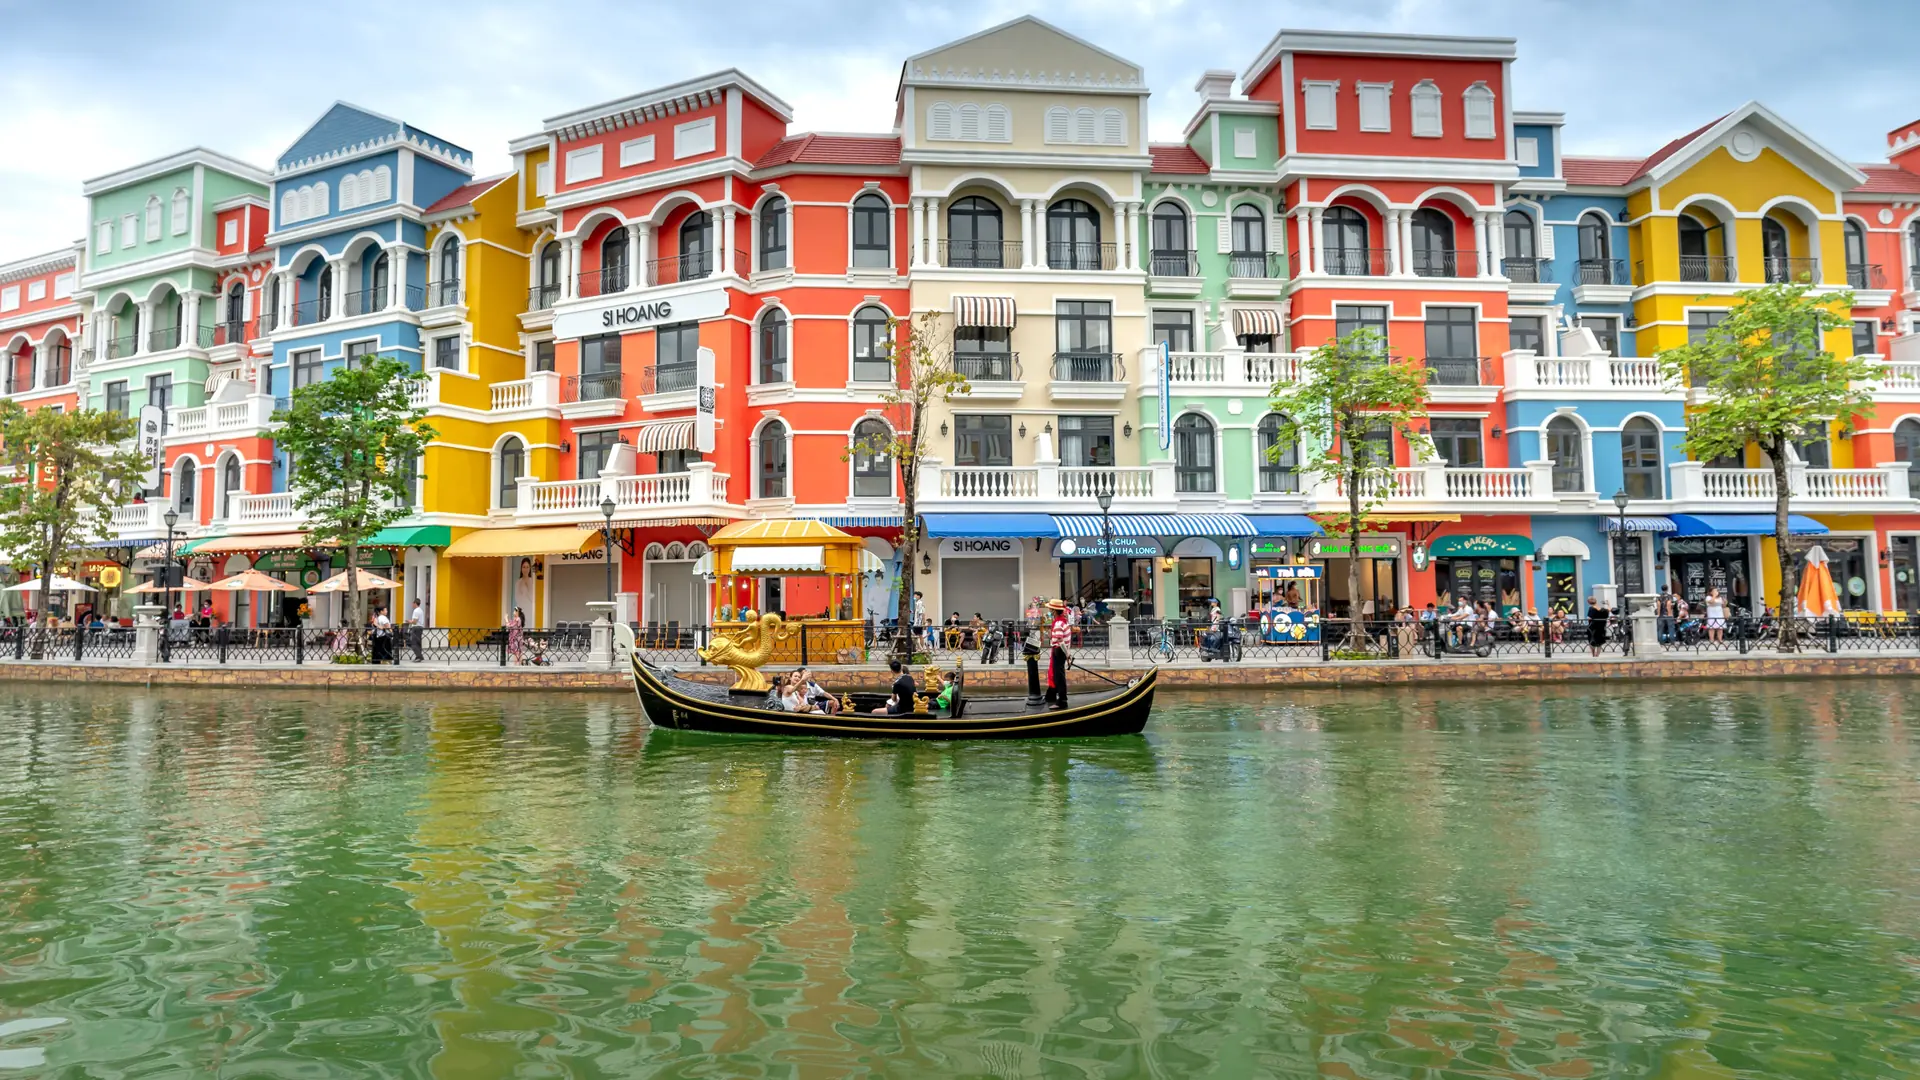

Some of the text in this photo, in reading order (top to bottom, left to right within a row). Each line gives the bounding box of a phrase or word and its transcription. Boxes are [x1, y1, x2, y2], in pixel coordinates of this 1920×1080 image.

[602, 301, 672, 327] SI HOANG
[953, 540, 1010, 552] SI HOANG
[1464, 536, 1499, 549] BAKERY
